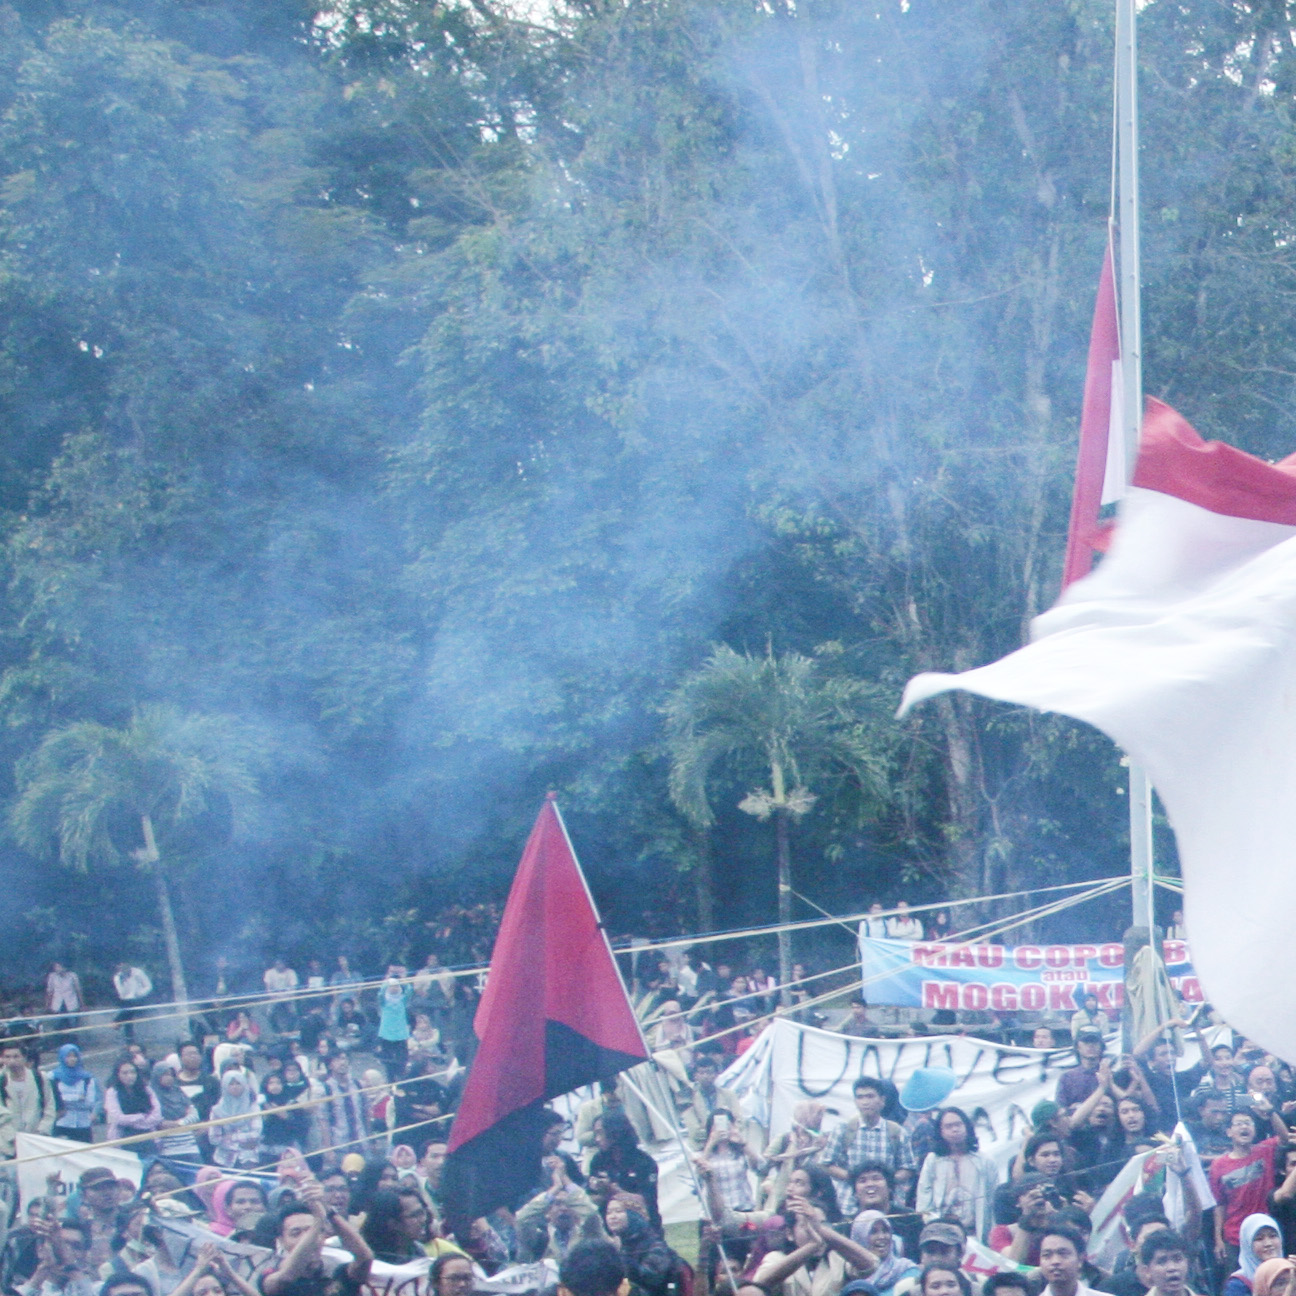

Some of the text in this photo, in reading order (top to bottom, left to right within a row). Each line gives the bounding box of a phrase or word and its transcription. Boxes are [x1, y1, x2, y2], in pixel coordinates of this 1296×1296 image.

[913, 943, 1003, 968] MAU
[1016, 944, 1125, 969] COPO
[1043, 970, 1088, 981] atau
[925, 982, 1076, 1010] MOGOK
